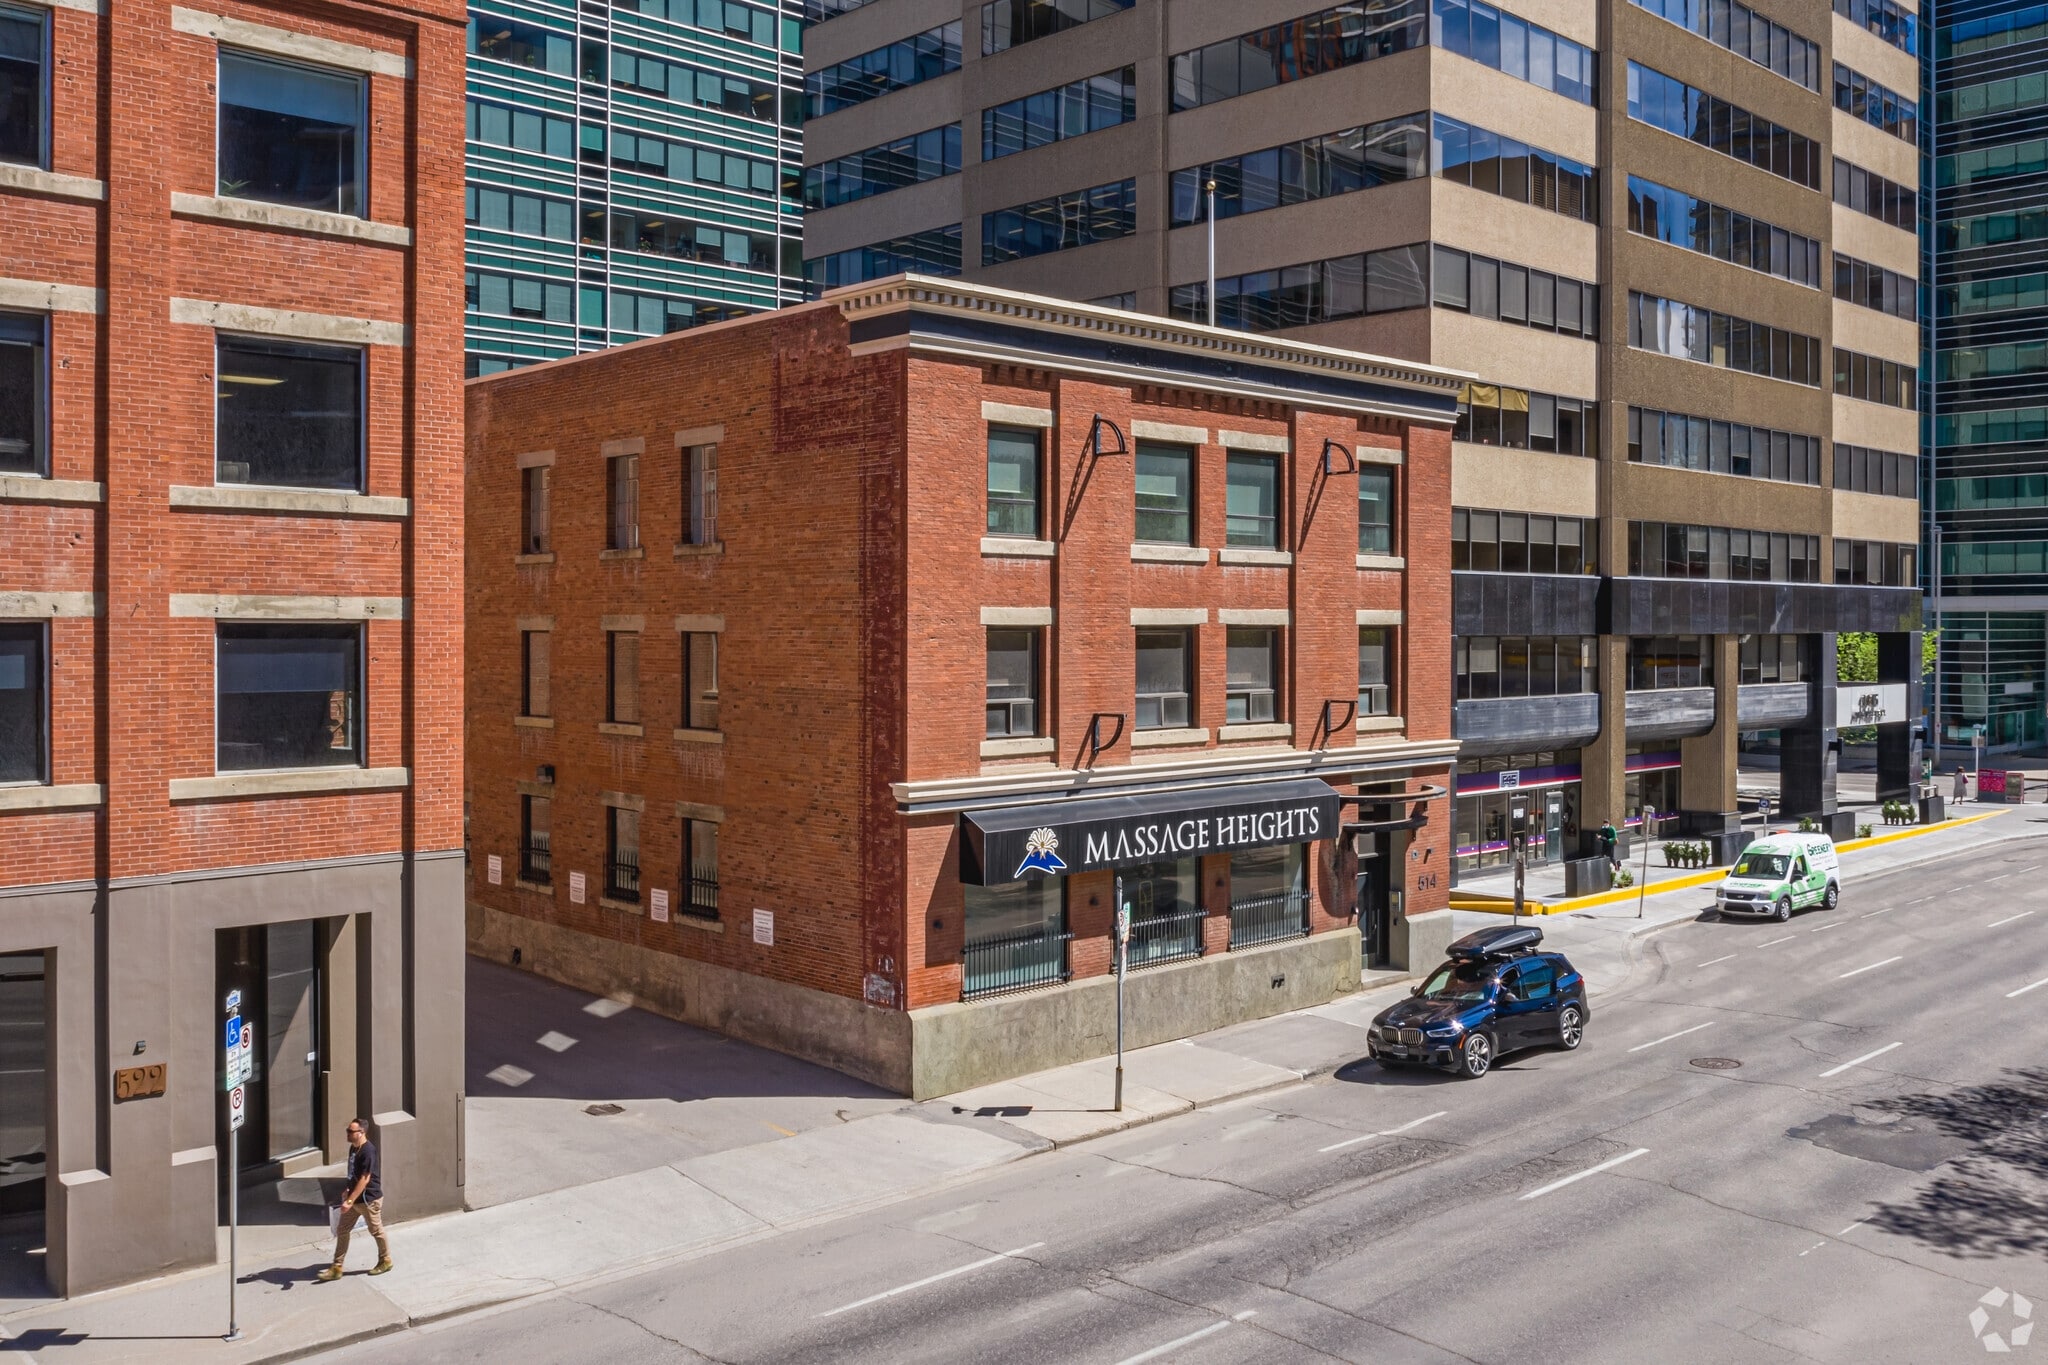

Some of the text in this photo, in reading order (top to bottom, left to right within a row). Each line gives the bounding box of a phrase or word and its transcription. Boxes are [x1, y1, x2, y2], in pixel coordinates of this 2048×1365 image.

[1084, 806, 1320, 864] MASSAGE HEIGHTS
[1417, 873, 1436, 891] 514
[117, 1064, 164, 1098] 522
